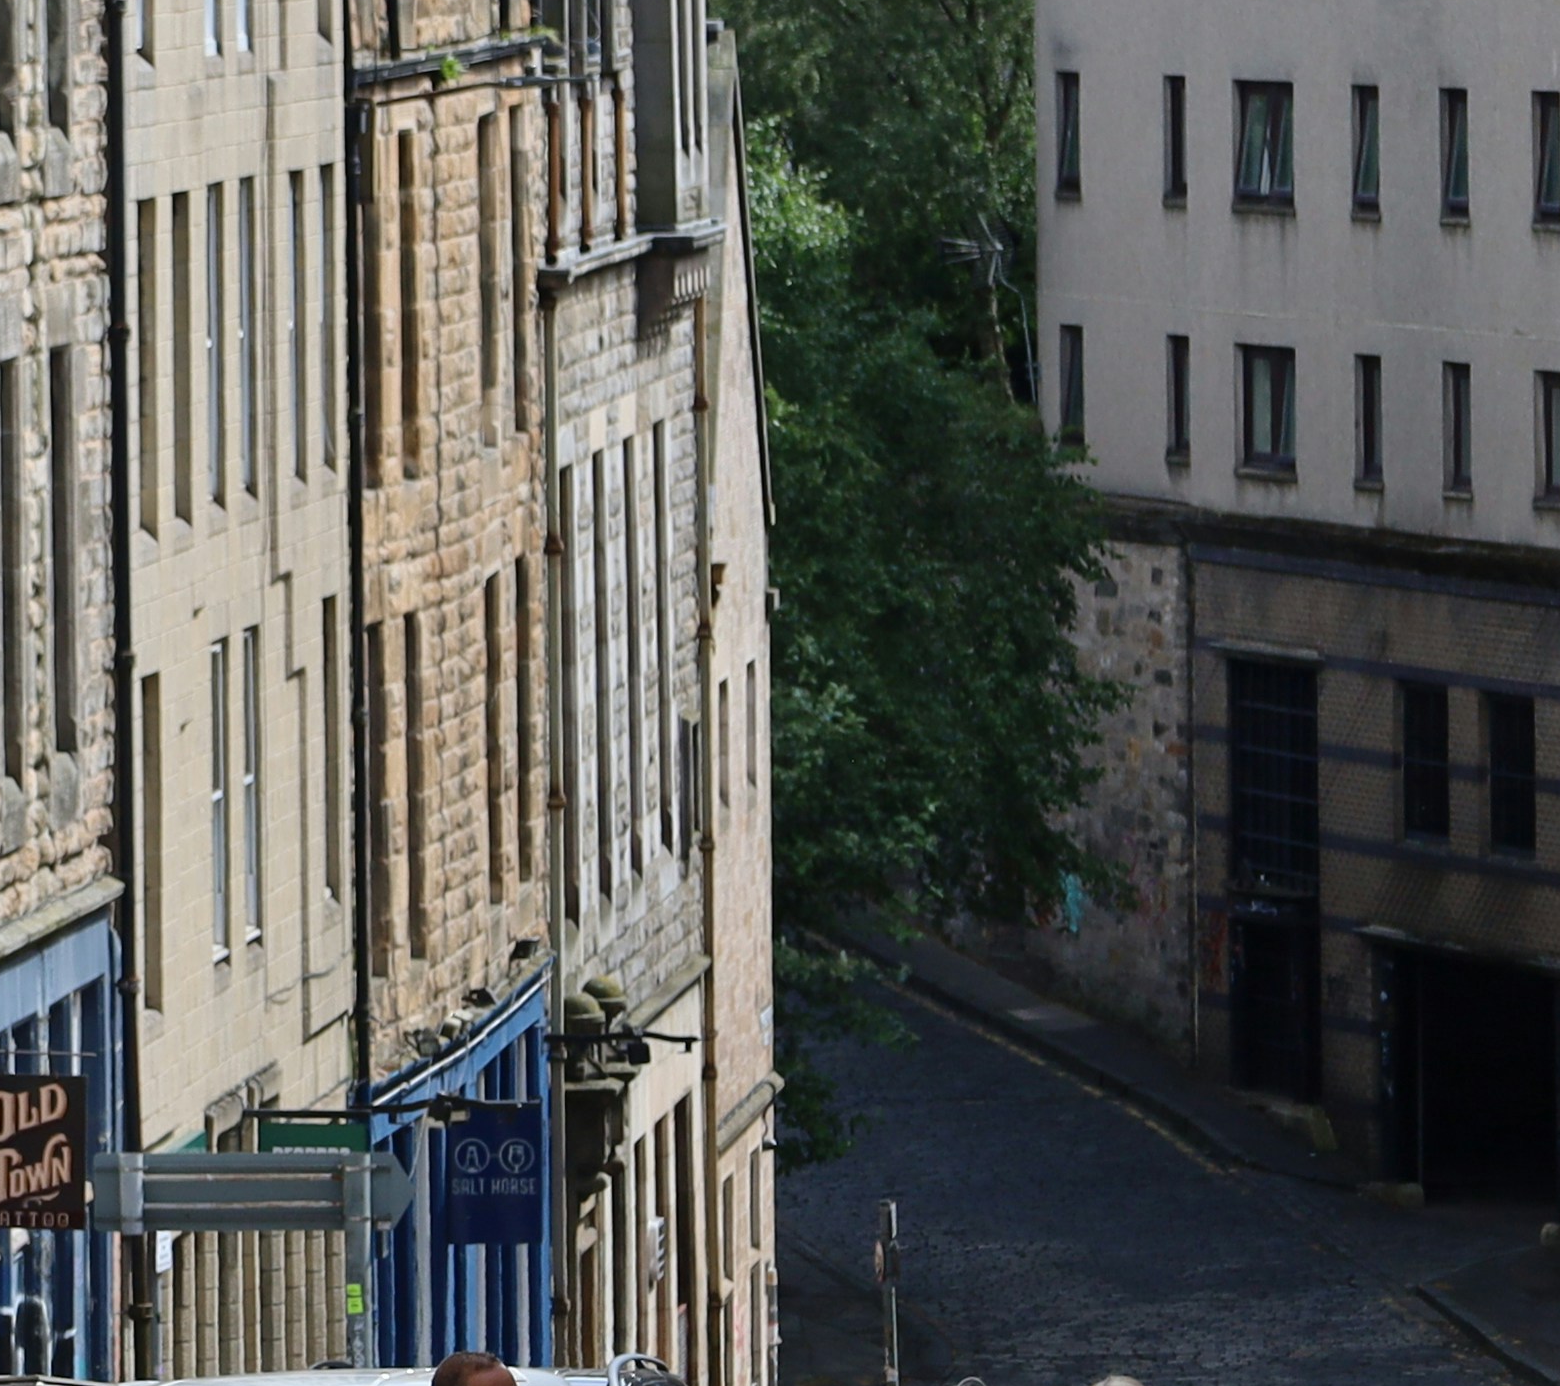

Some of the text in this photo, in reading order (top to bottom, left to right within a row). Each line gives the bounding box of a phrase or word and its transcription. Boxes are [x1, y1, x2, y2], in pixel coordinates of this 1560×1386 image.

[451, 1177, 537, 1196] SALT HORSE
[0, 1212, 70, 1228] ATTOO
